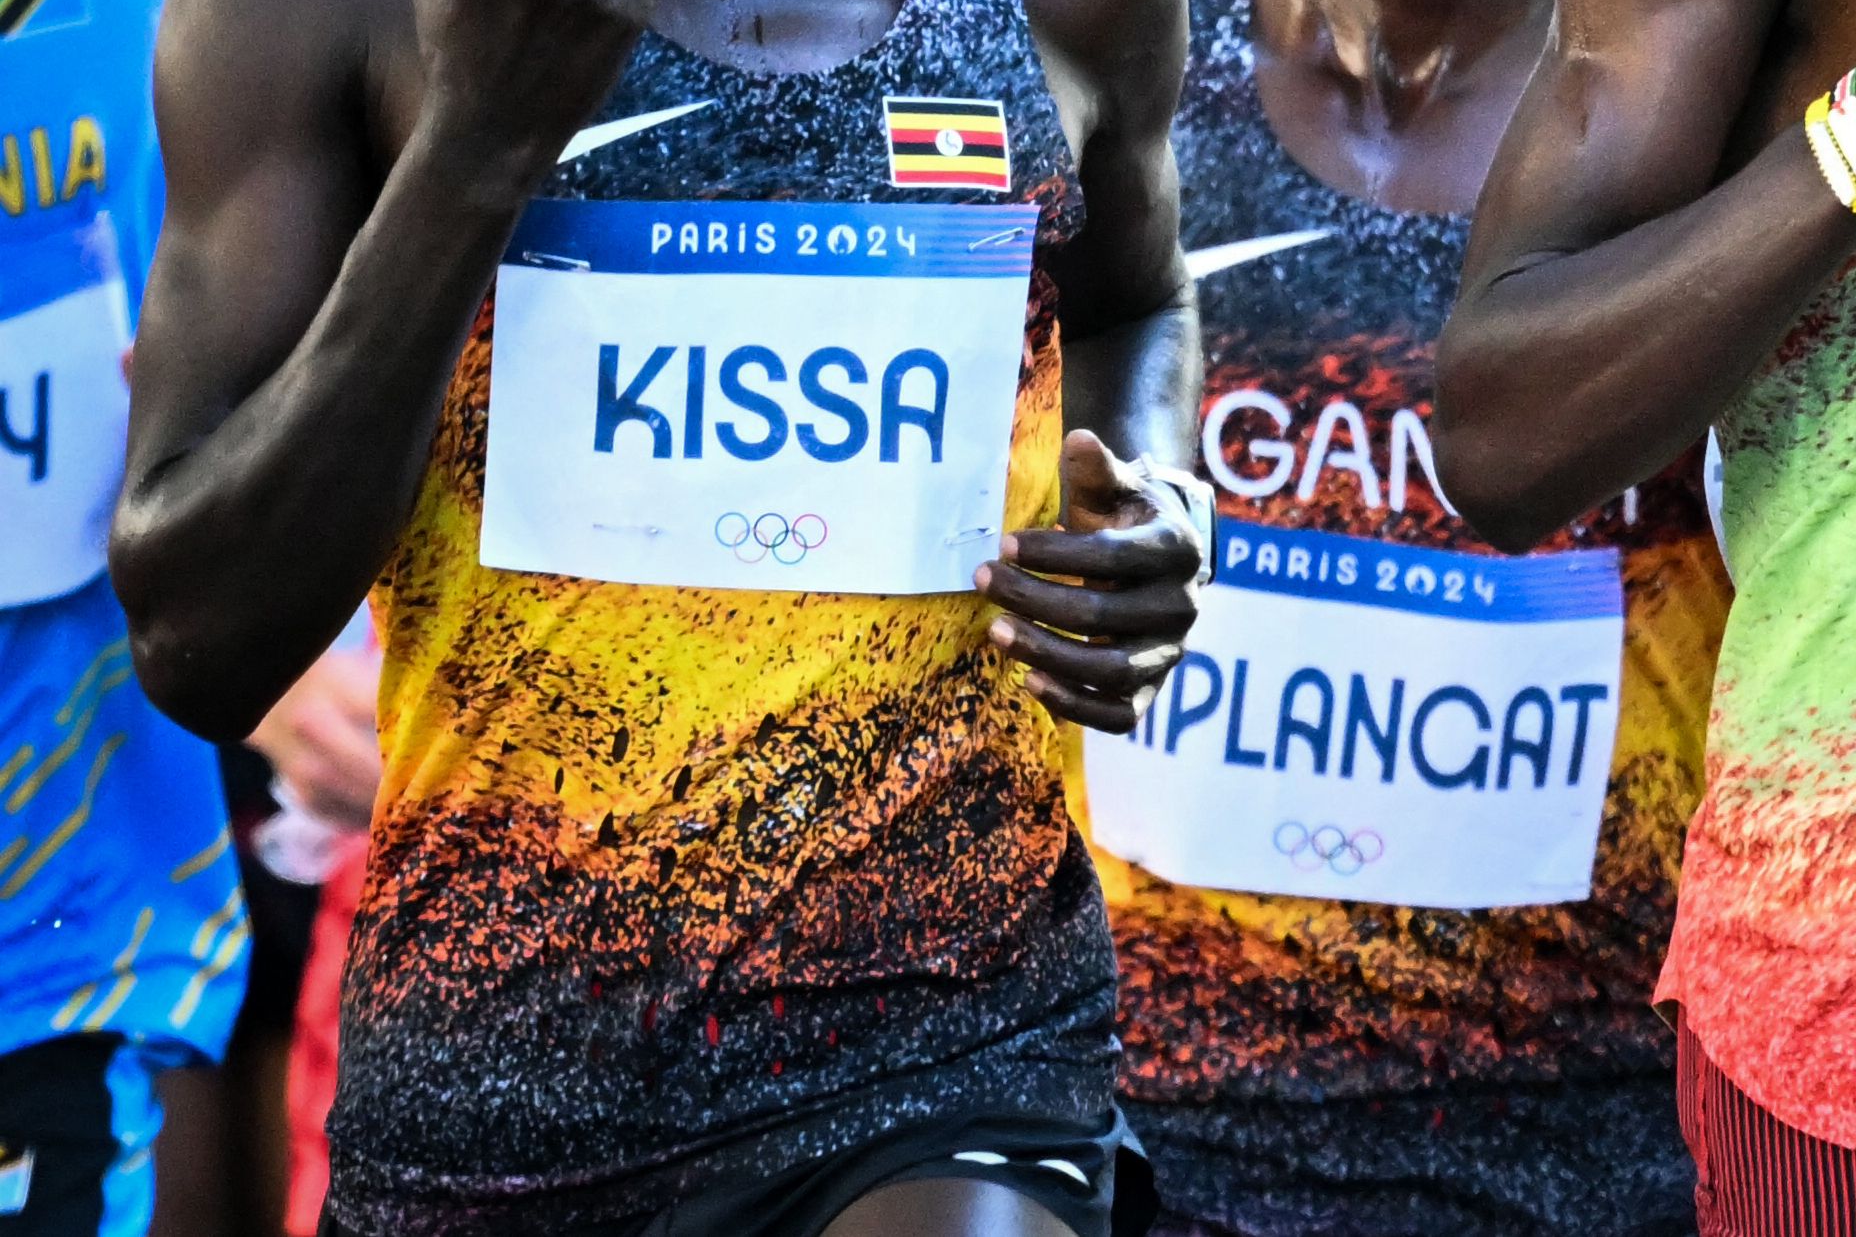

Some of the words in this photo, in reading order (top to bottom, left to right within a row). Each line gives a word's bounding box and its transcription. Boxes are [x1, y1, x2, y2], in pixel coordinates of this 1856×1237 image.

[651, 222, 777, 254] PARIS
[796, 223, 916, 256] 2024
[593, 343, 950, 464] KISSA
[1202, 389, 1638, 525] GAN
[1226, 536, 1359, 586] PARIS
[1375, 558, 1496, 606] 2024
[1127, 649, 1609, 791] PLANGAT
